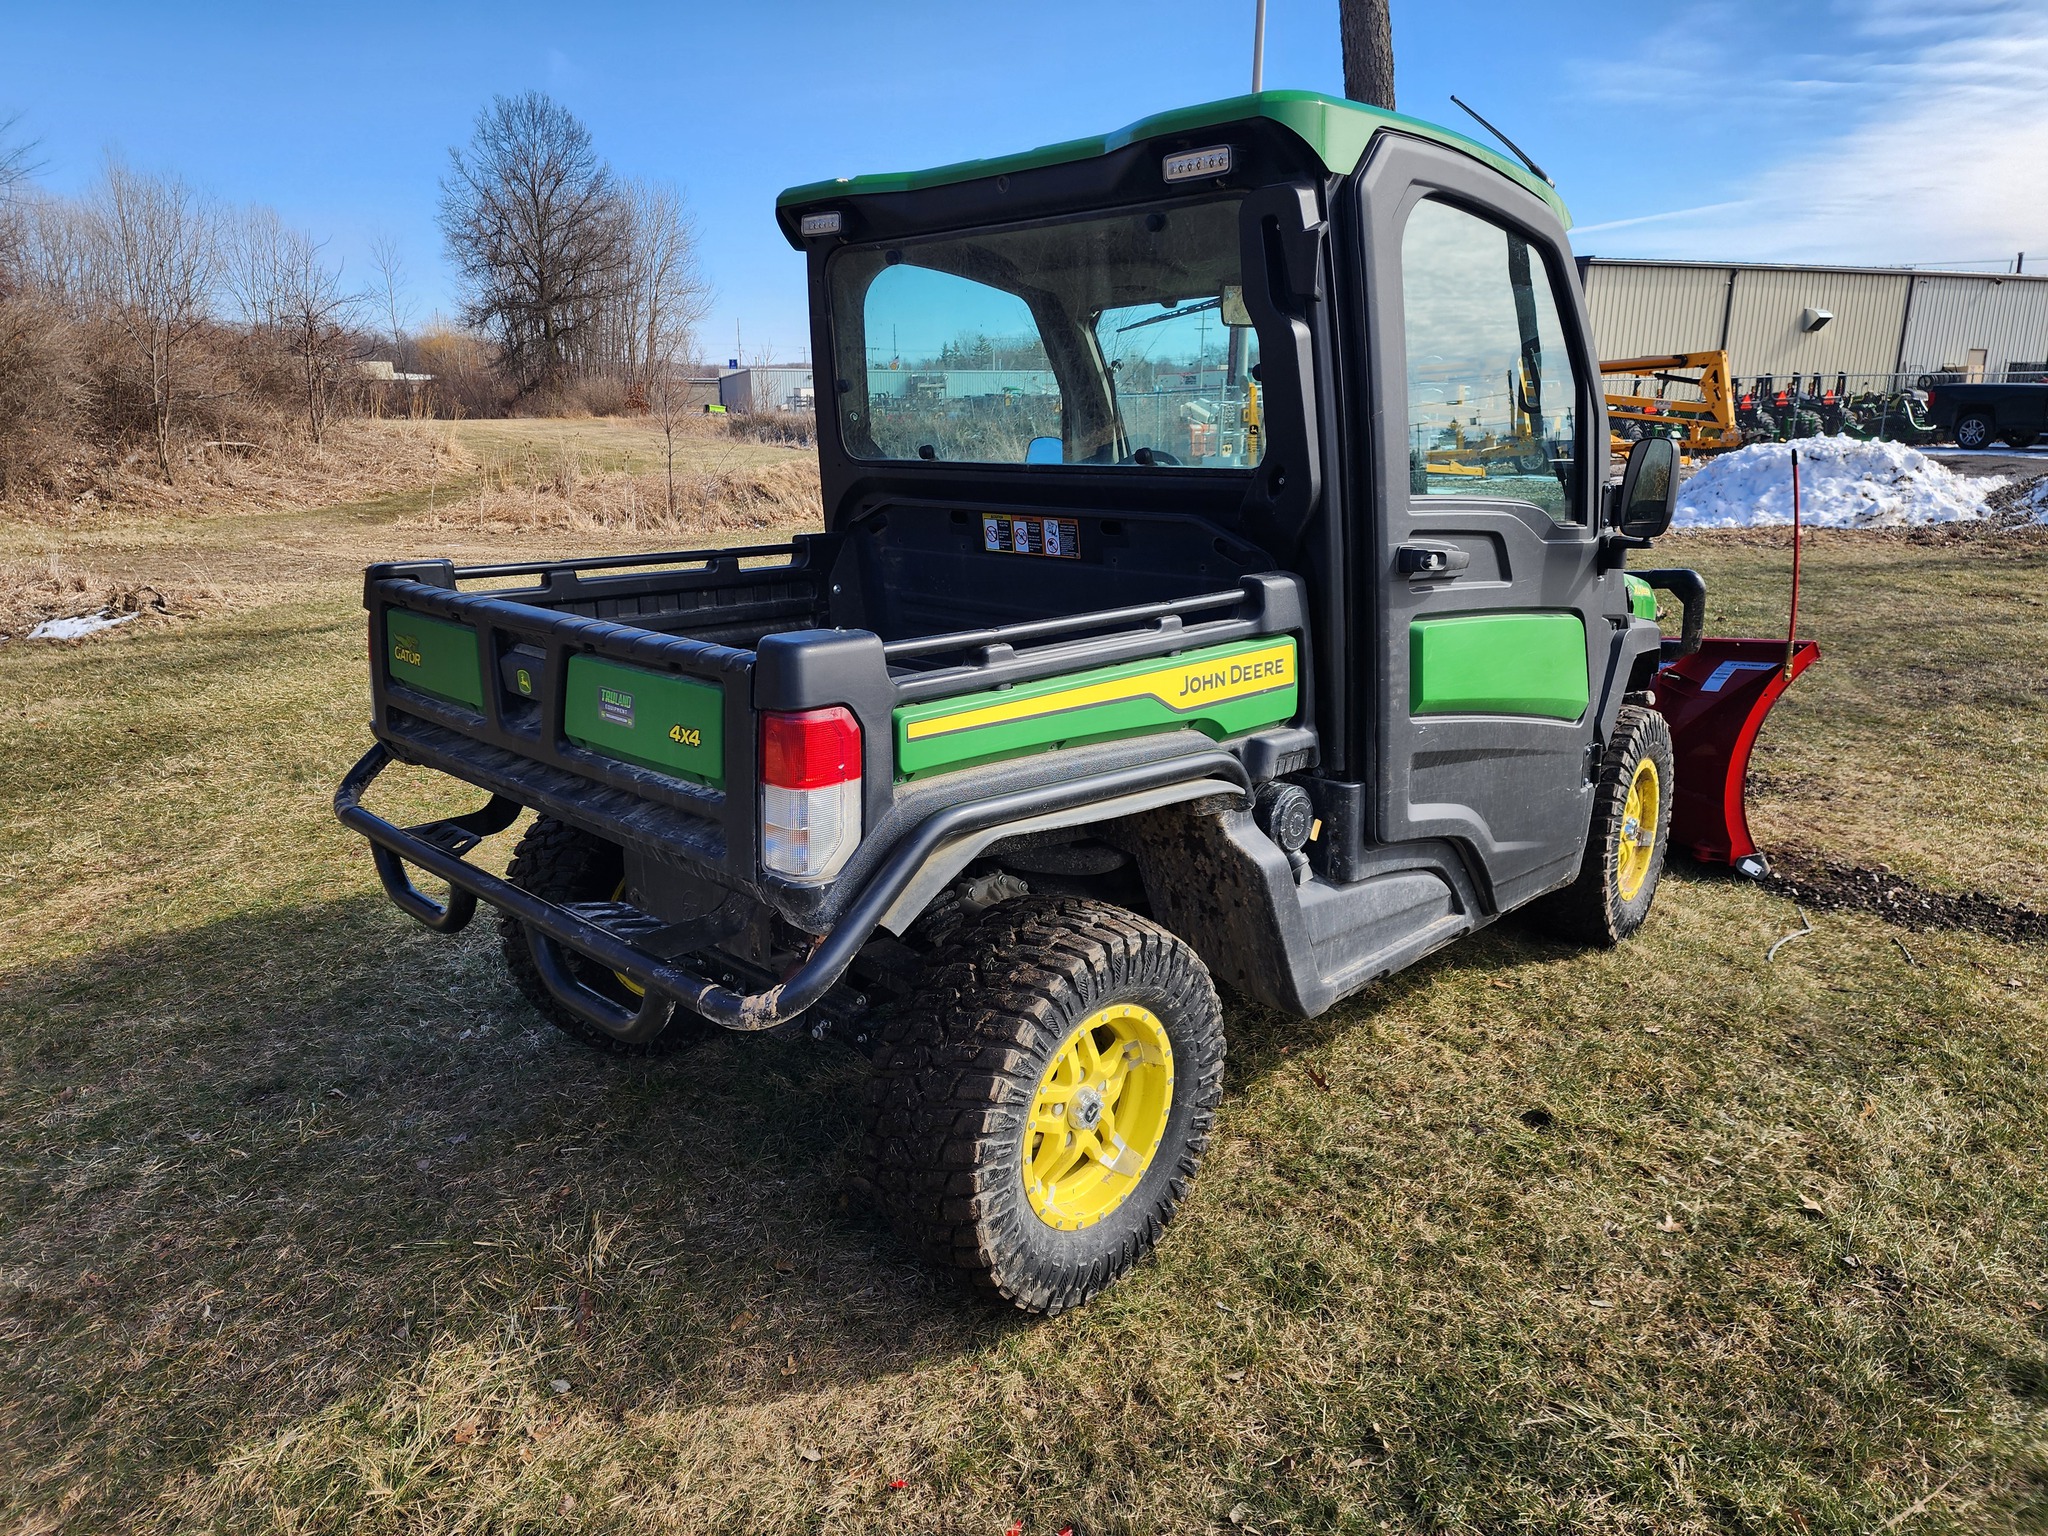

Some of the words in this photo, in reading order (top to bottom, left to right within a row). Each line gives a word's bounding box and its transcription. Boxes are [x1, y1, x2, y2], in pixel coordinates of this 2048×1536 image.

[394, 645, 421, 667] GATOR
[1180, 671, 1225, 696] JOHN
[1231, 659, 1284, 684] DEERE
[604, 704, 628, 715] EQUIPMENT
